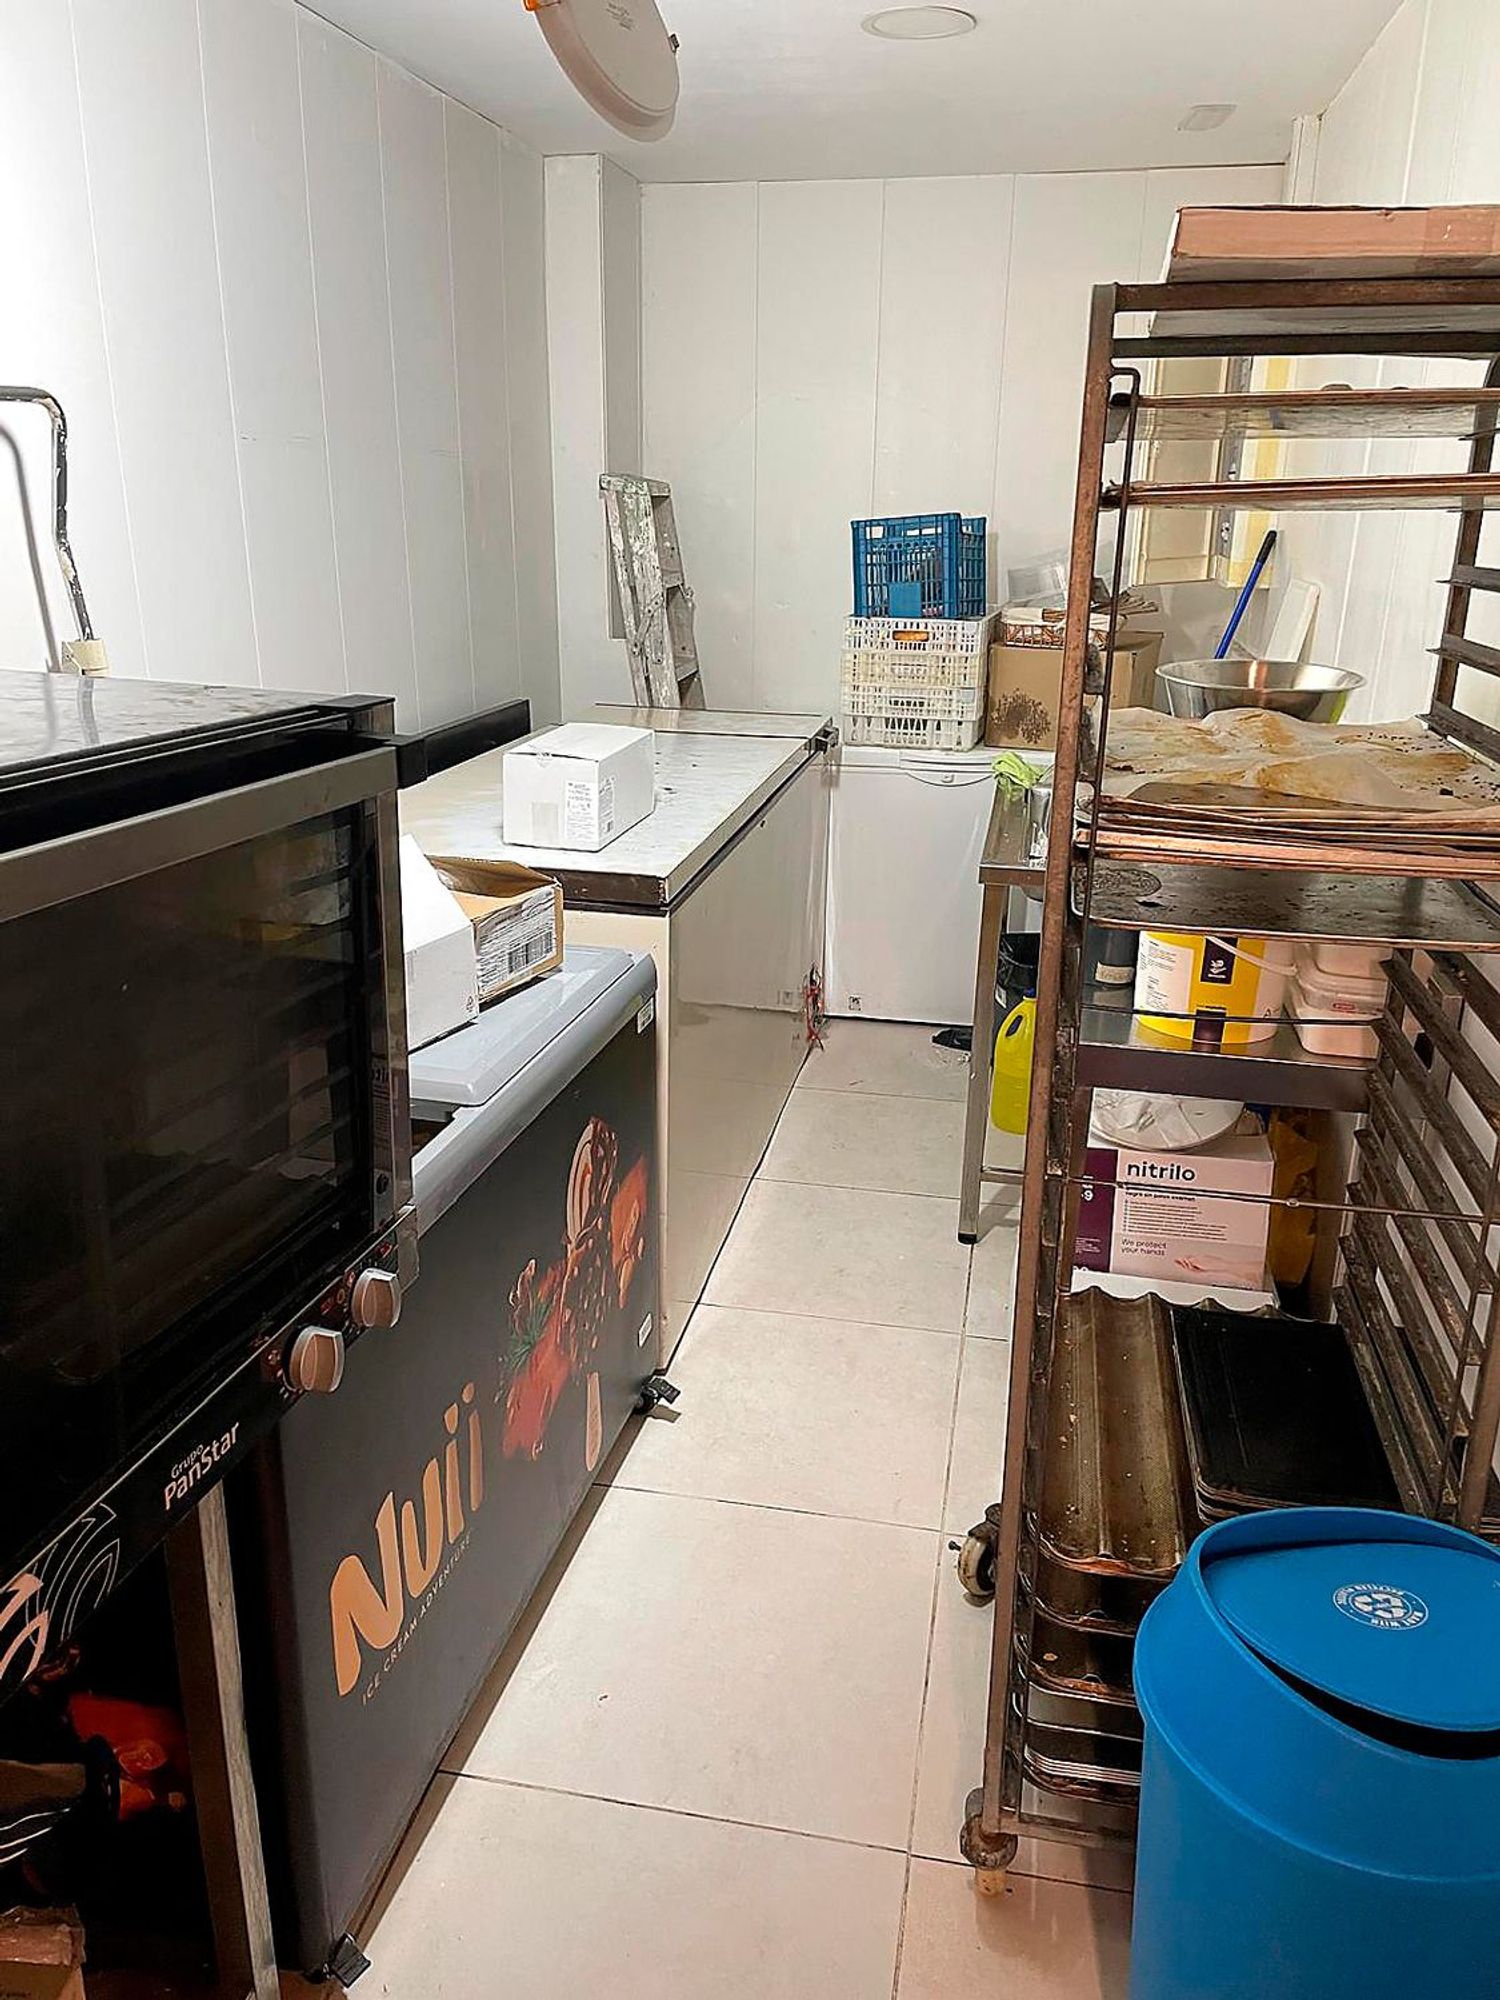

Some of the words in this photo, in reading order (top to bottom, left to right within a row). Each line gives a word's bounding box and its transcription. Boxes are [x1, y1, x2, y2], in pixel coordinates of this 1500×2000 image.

[1126, 1161, 1196, 1181] nitrilo
[164, 1421, 240, 1511] PanStar
[171, 1444, 204, 1479] Grupo
[362, 1671, 381, 1706] ICE
[384, 1617, 418, 1672] CREAM
[420, 1528, 473, 1619] ADVENTURE
